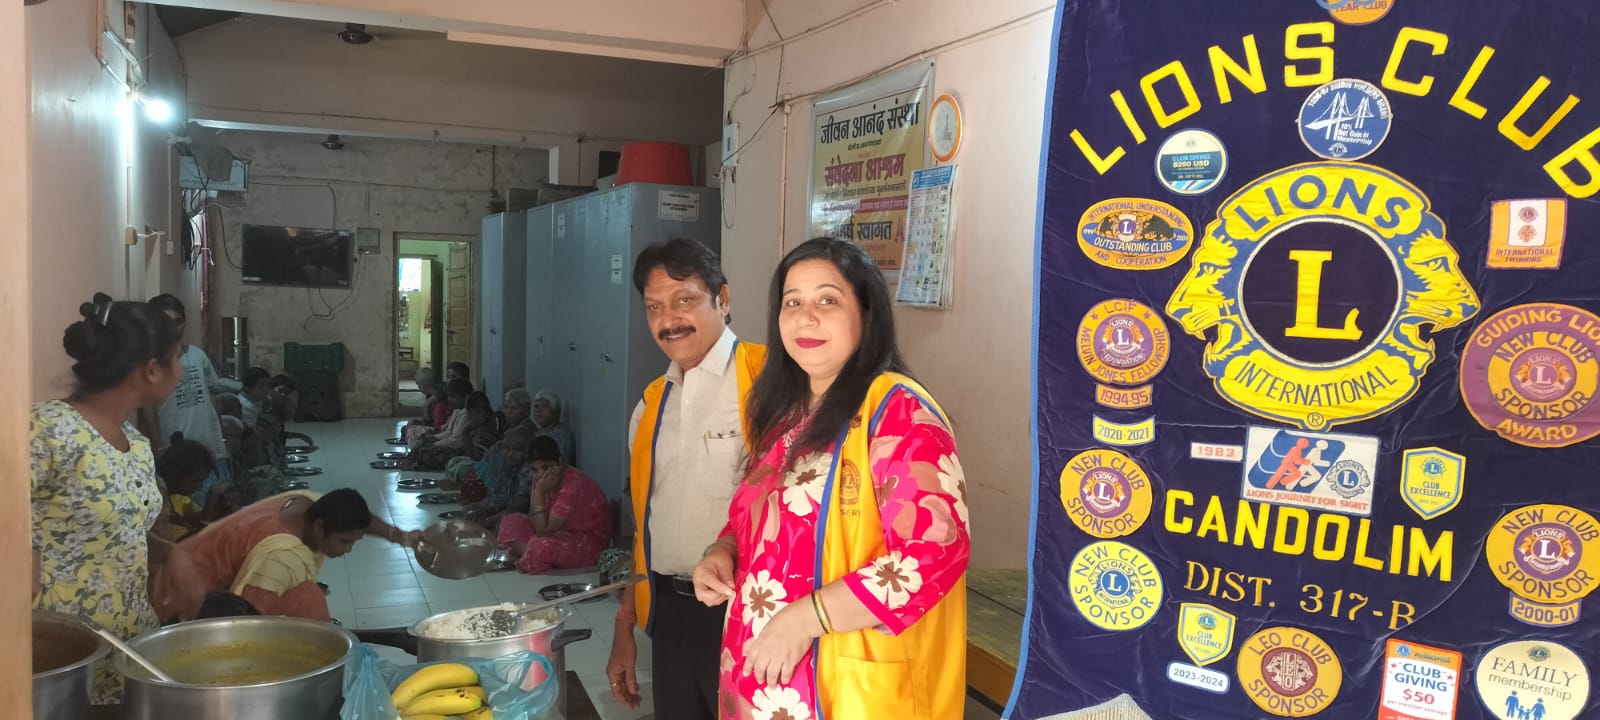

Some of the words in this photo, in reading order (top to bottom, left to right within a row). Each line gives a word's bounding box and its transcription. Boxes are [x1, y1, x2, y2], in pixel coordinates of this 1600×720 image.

[1069, 22, 1334, 175] LIONS
[1381, 27, 1600, 198] CLUB
[820, 115, 850, 144] जीवन
[852, 104, 885, 135] आनंद
[1089, 202, 1134, 220] INTERNATIONAL
[1137, 202, 1186, 226] UNDERSTANDING
[1234, 175, 1411, 232] LIONS
[857, 221, 893, 240] स्वागत
[1094, 237, 1149, 252] OUTSTANDING
[1150, 242, 1172, 252] CLUB
[1496, 248, 1554, 256] INTERNATIONAL
[1095, 250, 1109, 260] AND
[1116, 255, 1166, 266] COOPERATION
[1104, 301, 1136, 314] LCIF
[1285, 250, 1363, 341] L
[1477, 308, 1562, 348] GUIDING
[1080, 326, 1096, 366] MELVIN
[1092, 364, 1127, 383] JONES
[1131, 328, 1167, 382] FELLOWSHIP
[1495, 332, 1535, 363] NEW
[1546, 331, 1595, 364] CLUB
[1234, 361, 1397, 407] INTERNATIONAL
[1100, 390, 1149, 405] 1994-95
[1495, 388, 1590, 420] SPONSOR
[1498, 419, 1577, 441] AWARD
[1197, 445, 1236, 458] 1983
[1071, 454, 1102, 475] NEW
[1110, 458, 1145, 490] CLUB
[1423, 481, 1440, 489] CLUB
[1246, 489, 1274, 499] LIONS
[1276, 493, 1316, 503] JOURNEY
[1318, 497, 1336, 506] FOR
[1340, 501, 1368, 511] SIGHT
[1410, 487, 1451, 499] EXCELLENCE
[1067, 497, 1137, 534] SPONSOR
[1502, 509, 1544, 534] NEW
[1555, 510, 1599, 542] CLUB
[1165, 489, 1453, 582] CANDOLIM
[1535, 530, 1563, 539] LIONS
[1075, 545, 1109, 577] NEW
[1119, 548, 1157, 587] CLUB
[1101, 561, 1133, 575] LIONS
[1499, 560, 1594, 598] SPONSOR
[1075, 584, 1155, 625] SPONSOR
[1184, 560, 1275, 607] DIST.
[1299, 583, 1416, 630] 317-B
[1514, 603, 1576, 622] 2000-01
[1186, 634, 1222, 649] EXCELLENCE
[1198, 631, 1212, 639] CLUB
[1249, 632, 1282, 655] LEO
[1292, 633, 1332, 664] CLUB
[1174, 668, 1223, 687] 2023-2024
[1394, 673, 1447, 692] GIVING
[1403, 663, 1441, 678] CLUB
[1492, 657, 1578, 687] FAMILY
[1248, 678, 1329, 714] SPONSOR
[1402, 688, 1435, 704] $50
[1488, 673, 1572, 702] membership
